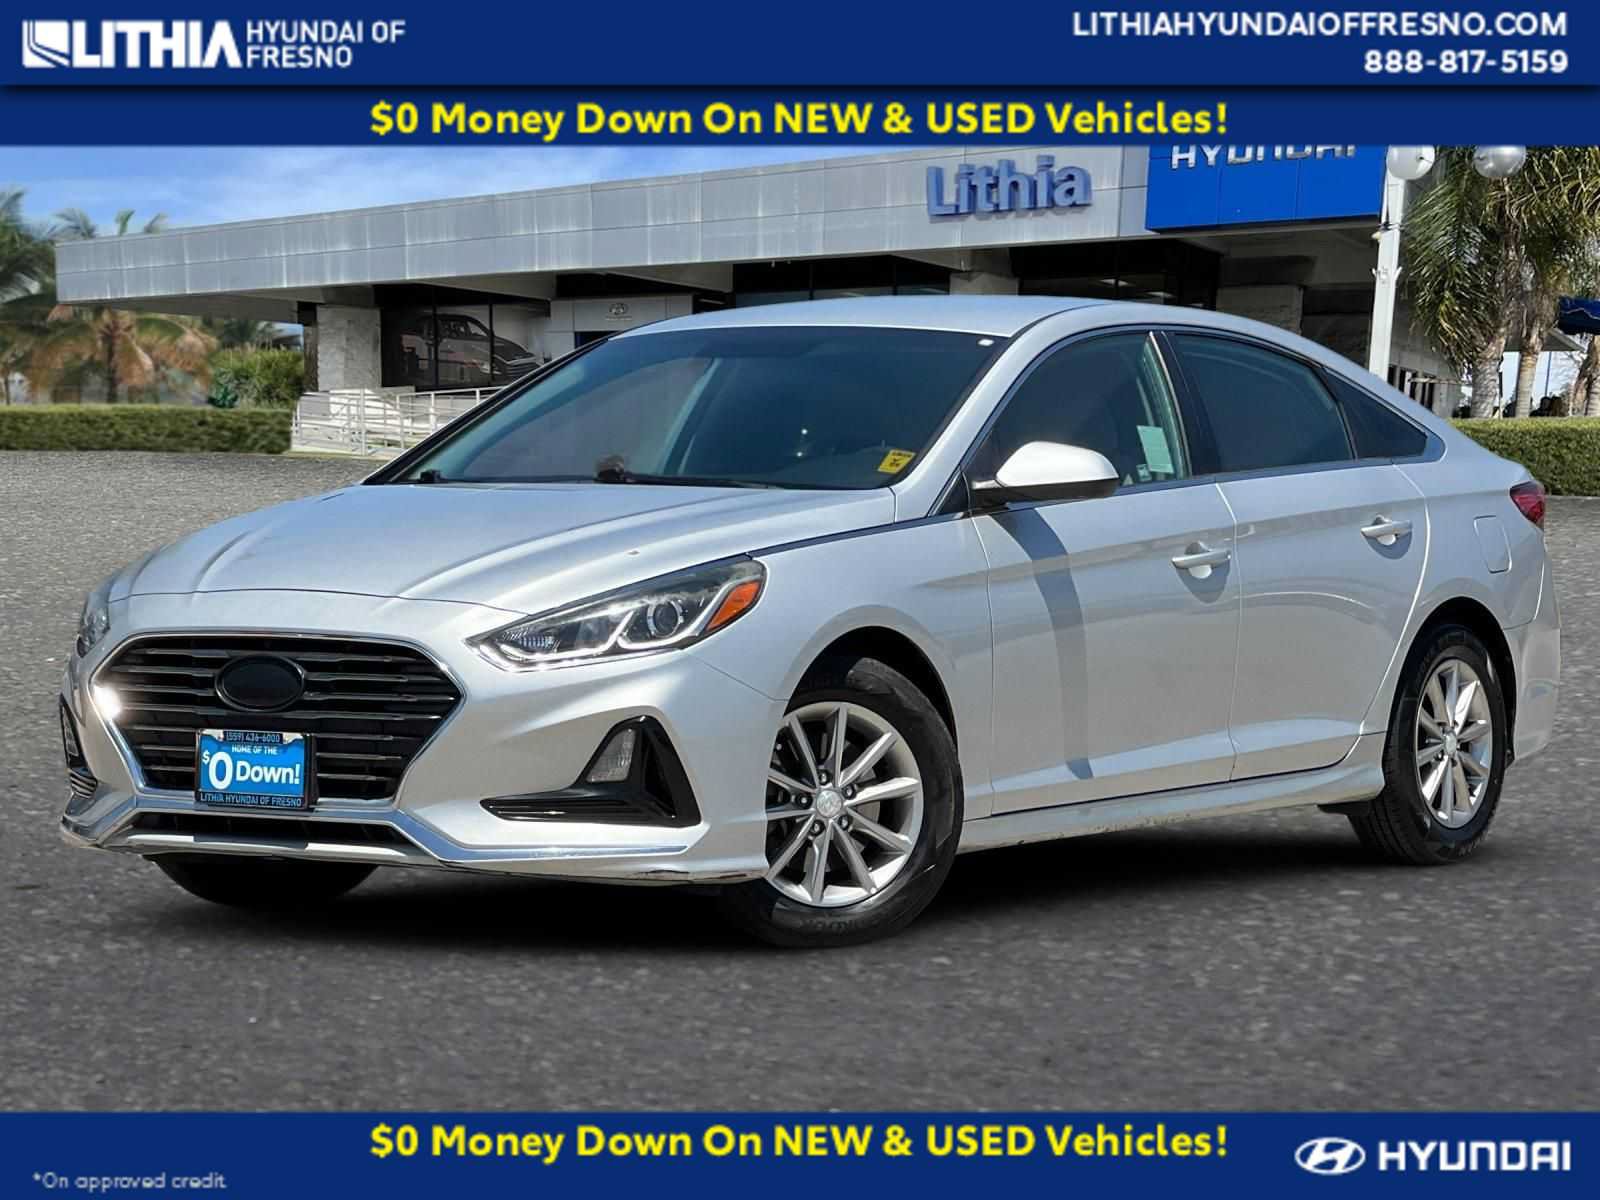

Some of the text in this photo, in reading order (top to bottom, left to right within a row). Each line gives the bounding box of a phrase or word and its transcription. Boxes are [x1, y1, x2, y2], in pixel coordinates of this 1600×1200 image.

[927, 154, 1092, 216] Lithia
[231, 745, 278, 755] HOME OF THE
[236, 761, 301, 785] Down!
[200, 792, 302, 807] LITHIA HYUNDAI OF FRESNO
